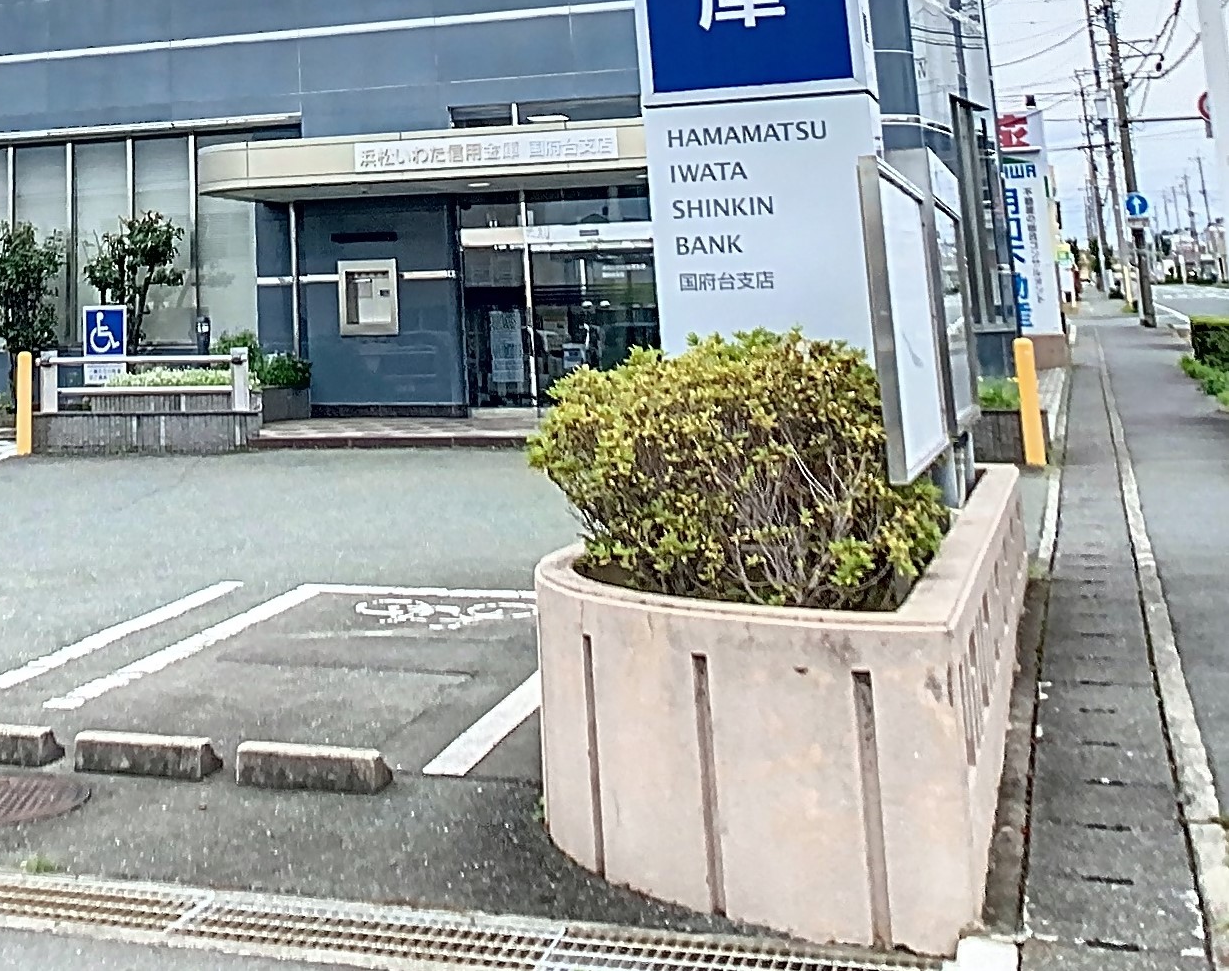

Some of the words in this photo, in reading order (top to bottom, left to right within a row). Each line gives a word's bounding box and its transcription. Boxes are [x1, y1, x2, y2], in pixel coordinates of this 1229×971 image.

[667, 120, 827, 148] HAMAMATSU
[360, 141, 520, 168] 浜松いわた信用金庫
[670, 161, 748, 183] IWATA
[672, 196, 774, 220] SHINKIN
[676, 234, 743, 256] BANK
[679, 271, 775, 292] 国府台支店
